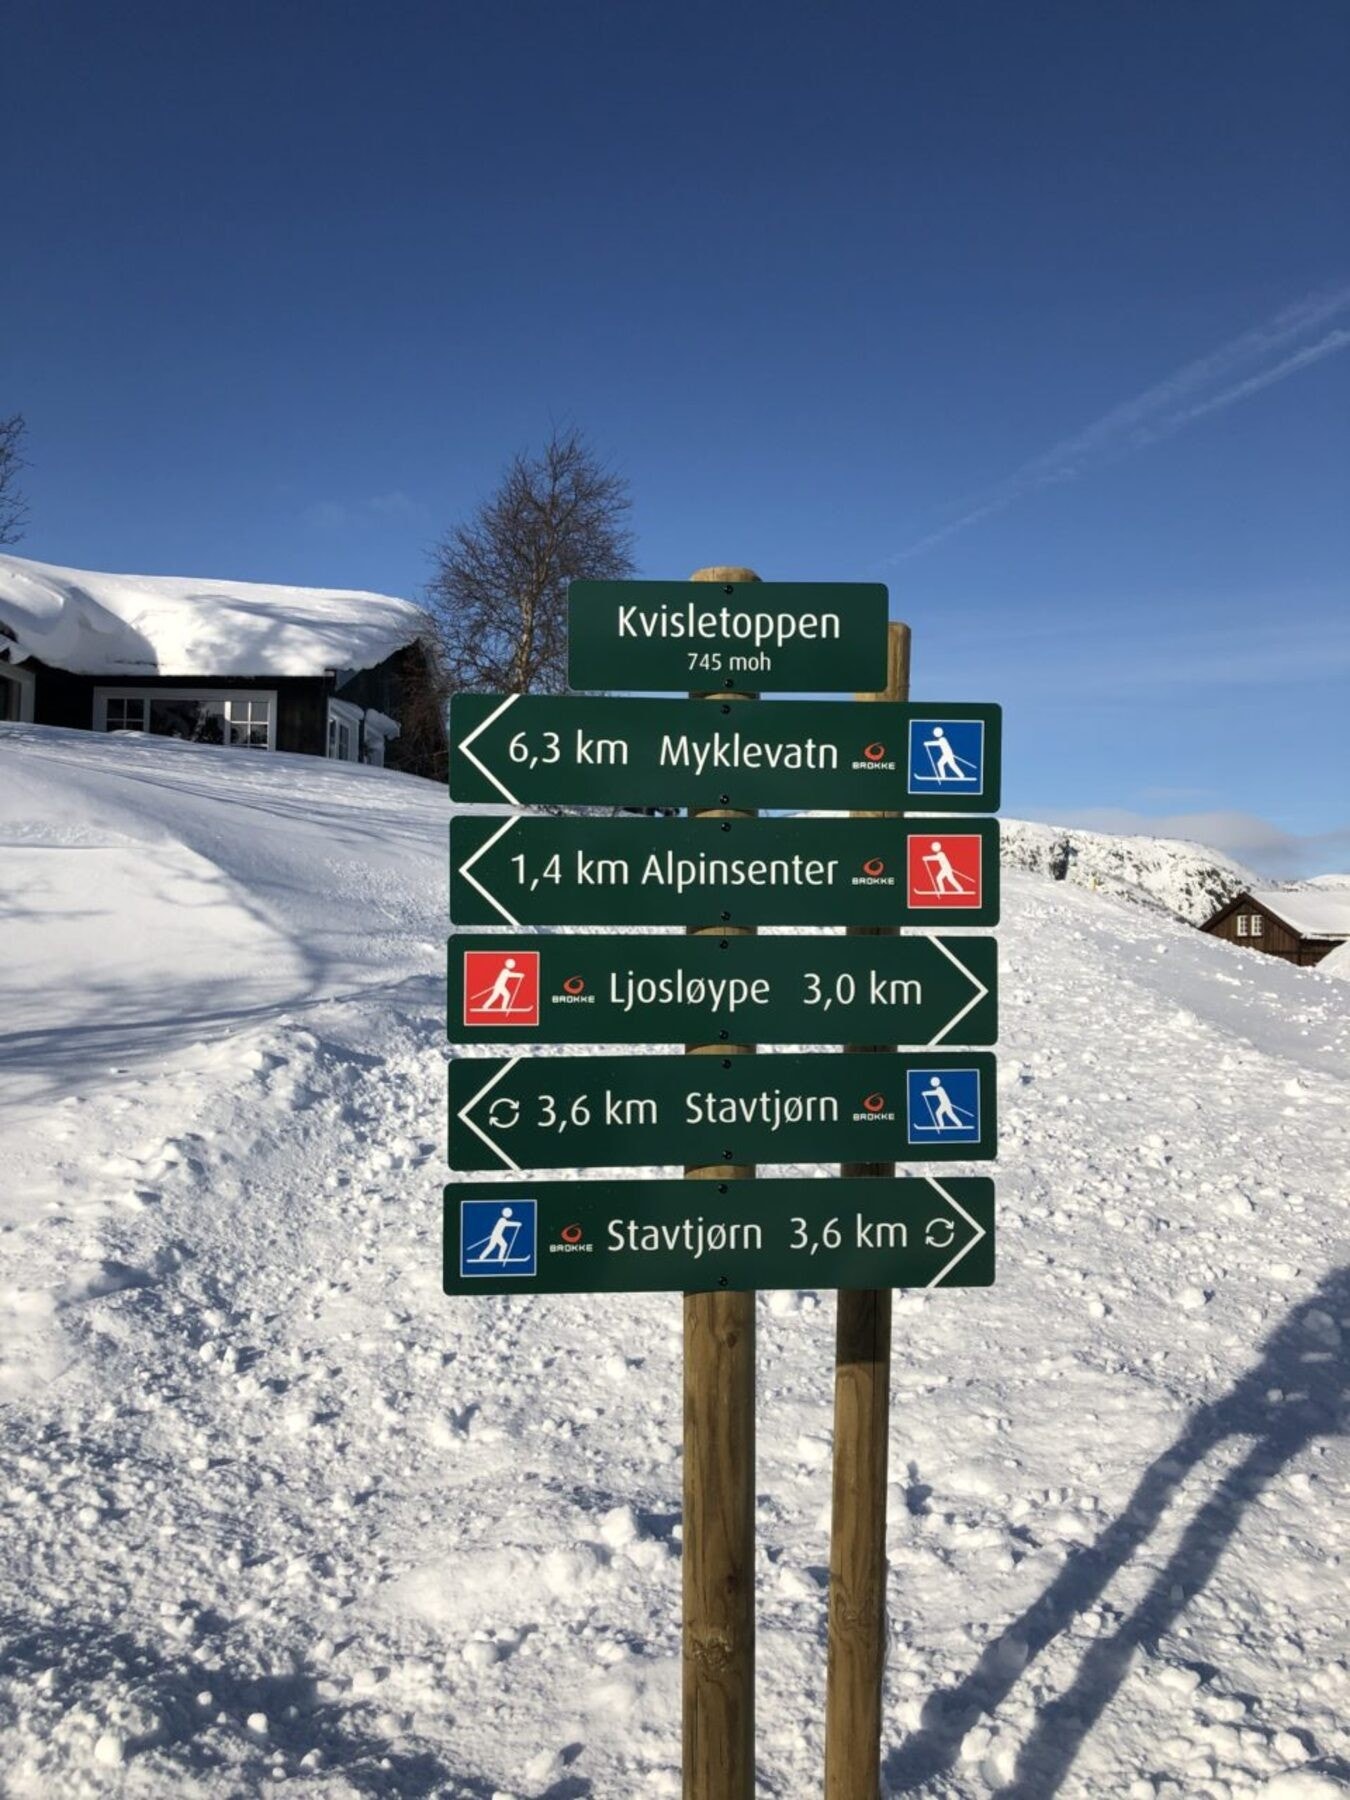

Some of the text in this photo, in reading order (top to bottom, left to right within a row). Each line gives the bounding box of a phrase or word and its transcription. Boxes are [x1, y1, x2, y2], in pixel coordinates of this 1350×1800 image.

[618, 602, 840, 648] Kvisletoppen
[687, 651, 771, 671] 745 moh
[508, 728, 838, 776] 6,3 km Myklevatn
[851, 761, 896, 770] BROKKE
[511, 849, 839, 894] 1,4 km Alpinsenter
[851, 877, 895, 886] BROKKE
[551, 995, 595, 1004] BROKKE
[610, 968, 922, 1013] Ljosløype 3,0 km
[537, 1089, 838, 1133] 3,6 km Stavtjørn
[852, 1113, 895, 1121] BROKKE
[549, 1243, 593, 1253] BROKKE
[607, 1212, 908, 1259] Stavtjørn 3,6 km
